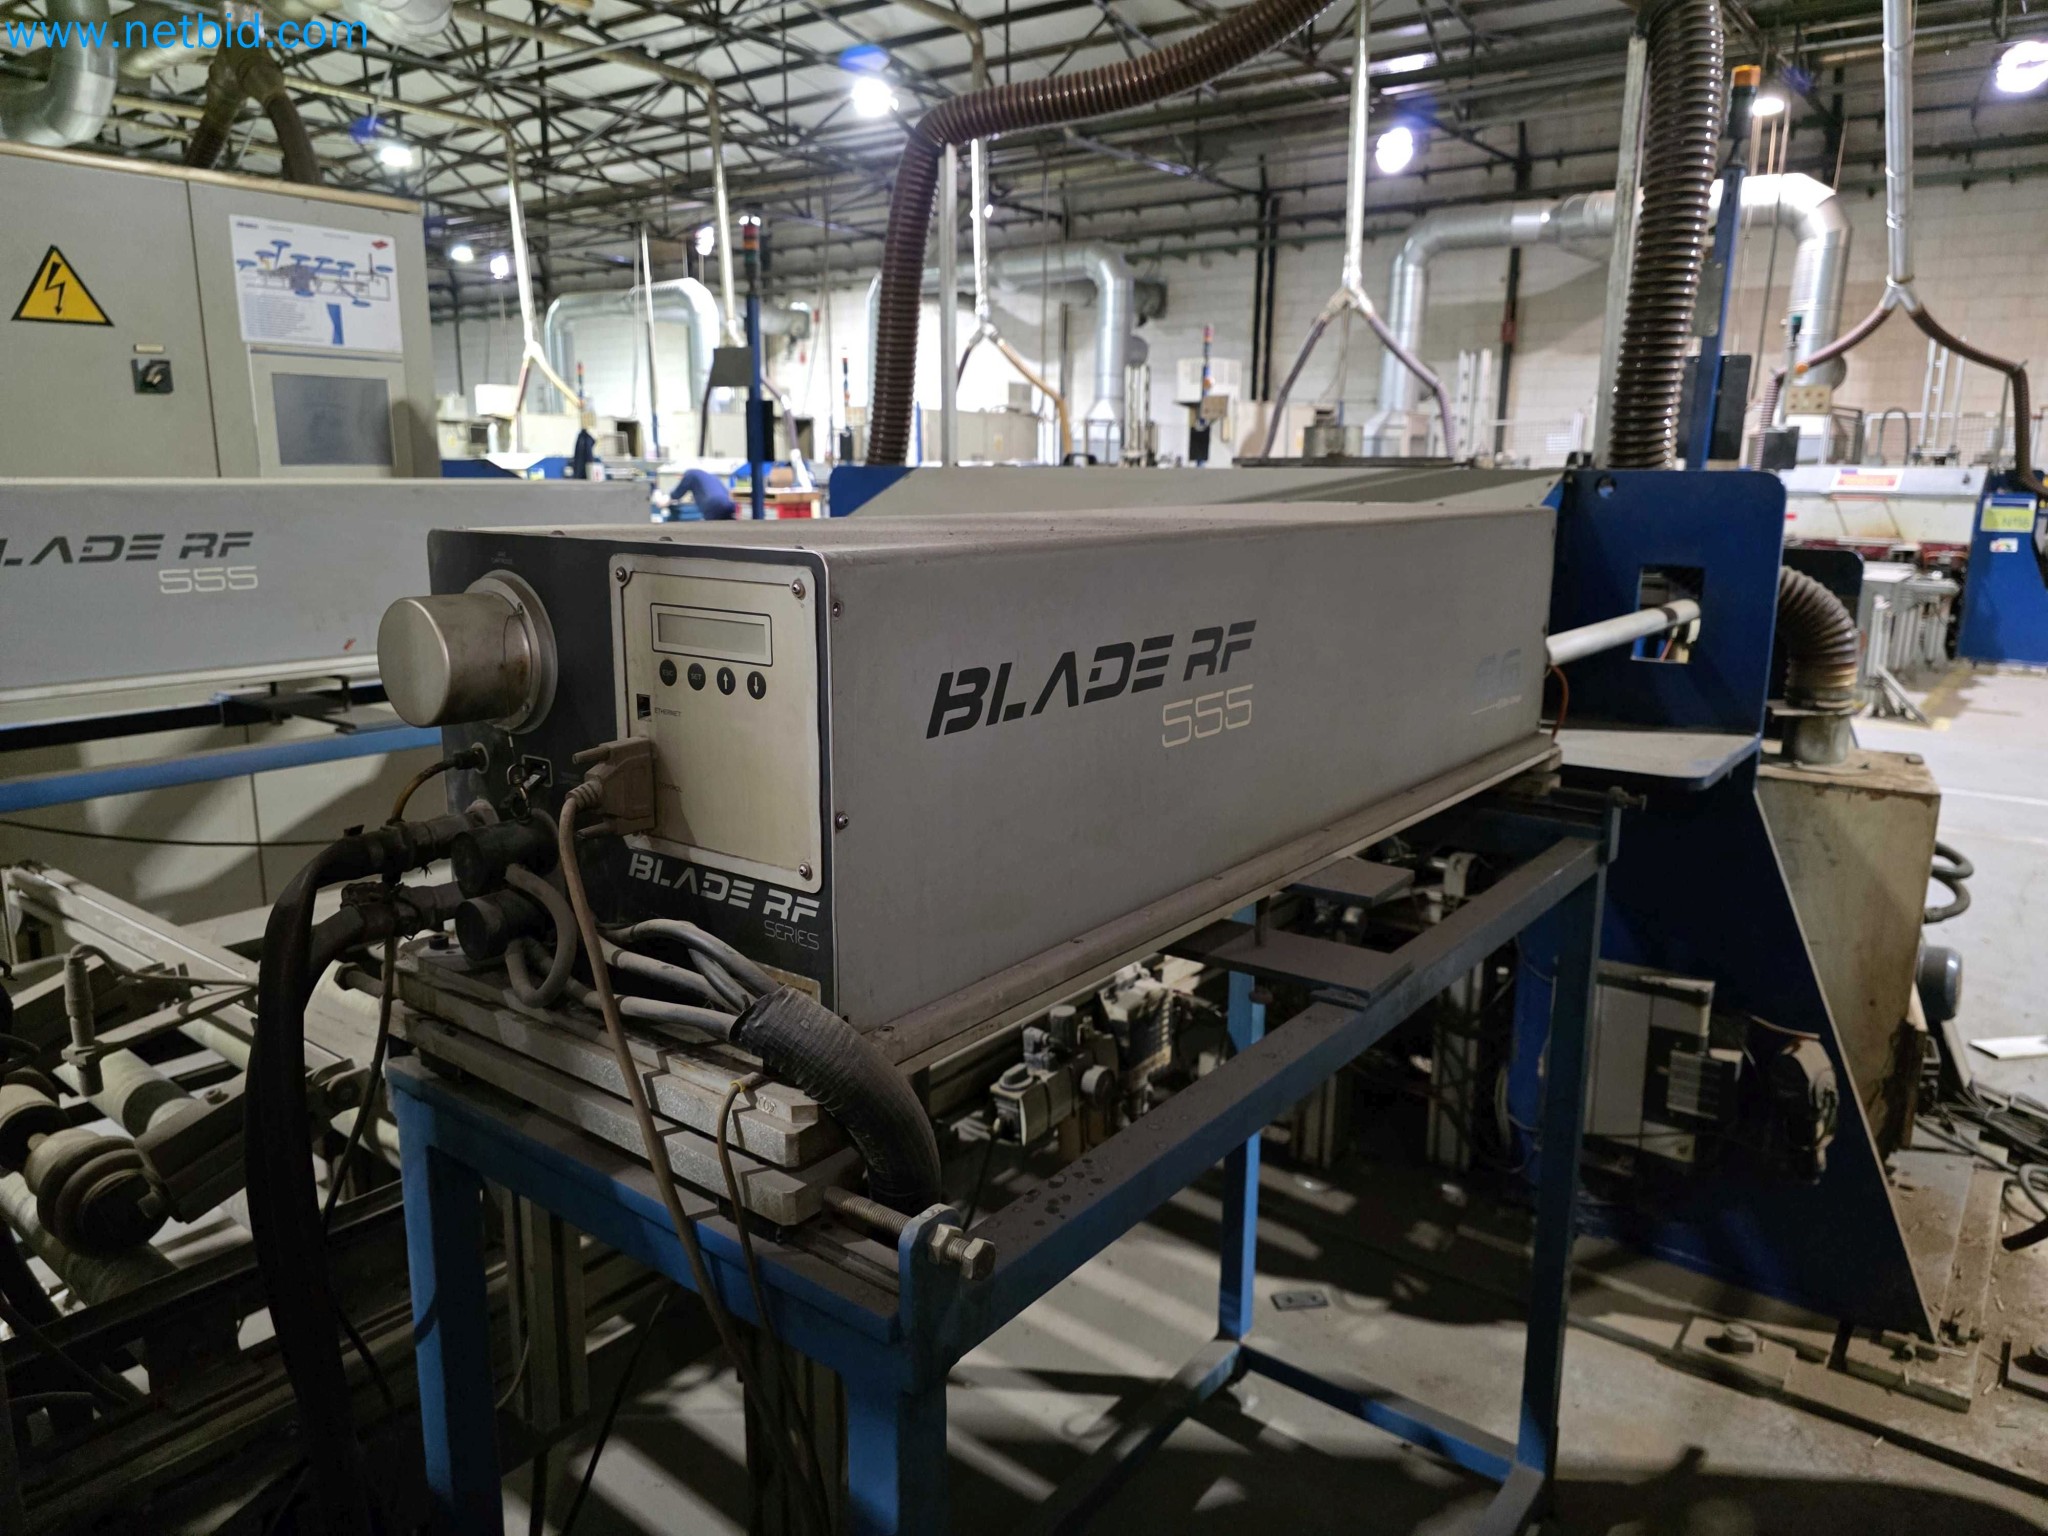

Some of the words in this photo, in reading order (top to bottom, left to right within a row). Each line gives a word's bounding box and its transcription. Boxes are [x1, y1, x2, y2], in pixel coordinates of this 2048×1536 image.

[178, 531, 254, 560] RF
[925, 633, 1176, 740] BLADE
[1182, 619, 1258, 683] RF
[654, 707, 682, 717] ETHERNET
[1161, 683, 1254, 748] 555
[627, 853, 755, 910] BLADE
[762, 888, 821, 923] RF
[763, 919, 821, 951] SERIES
